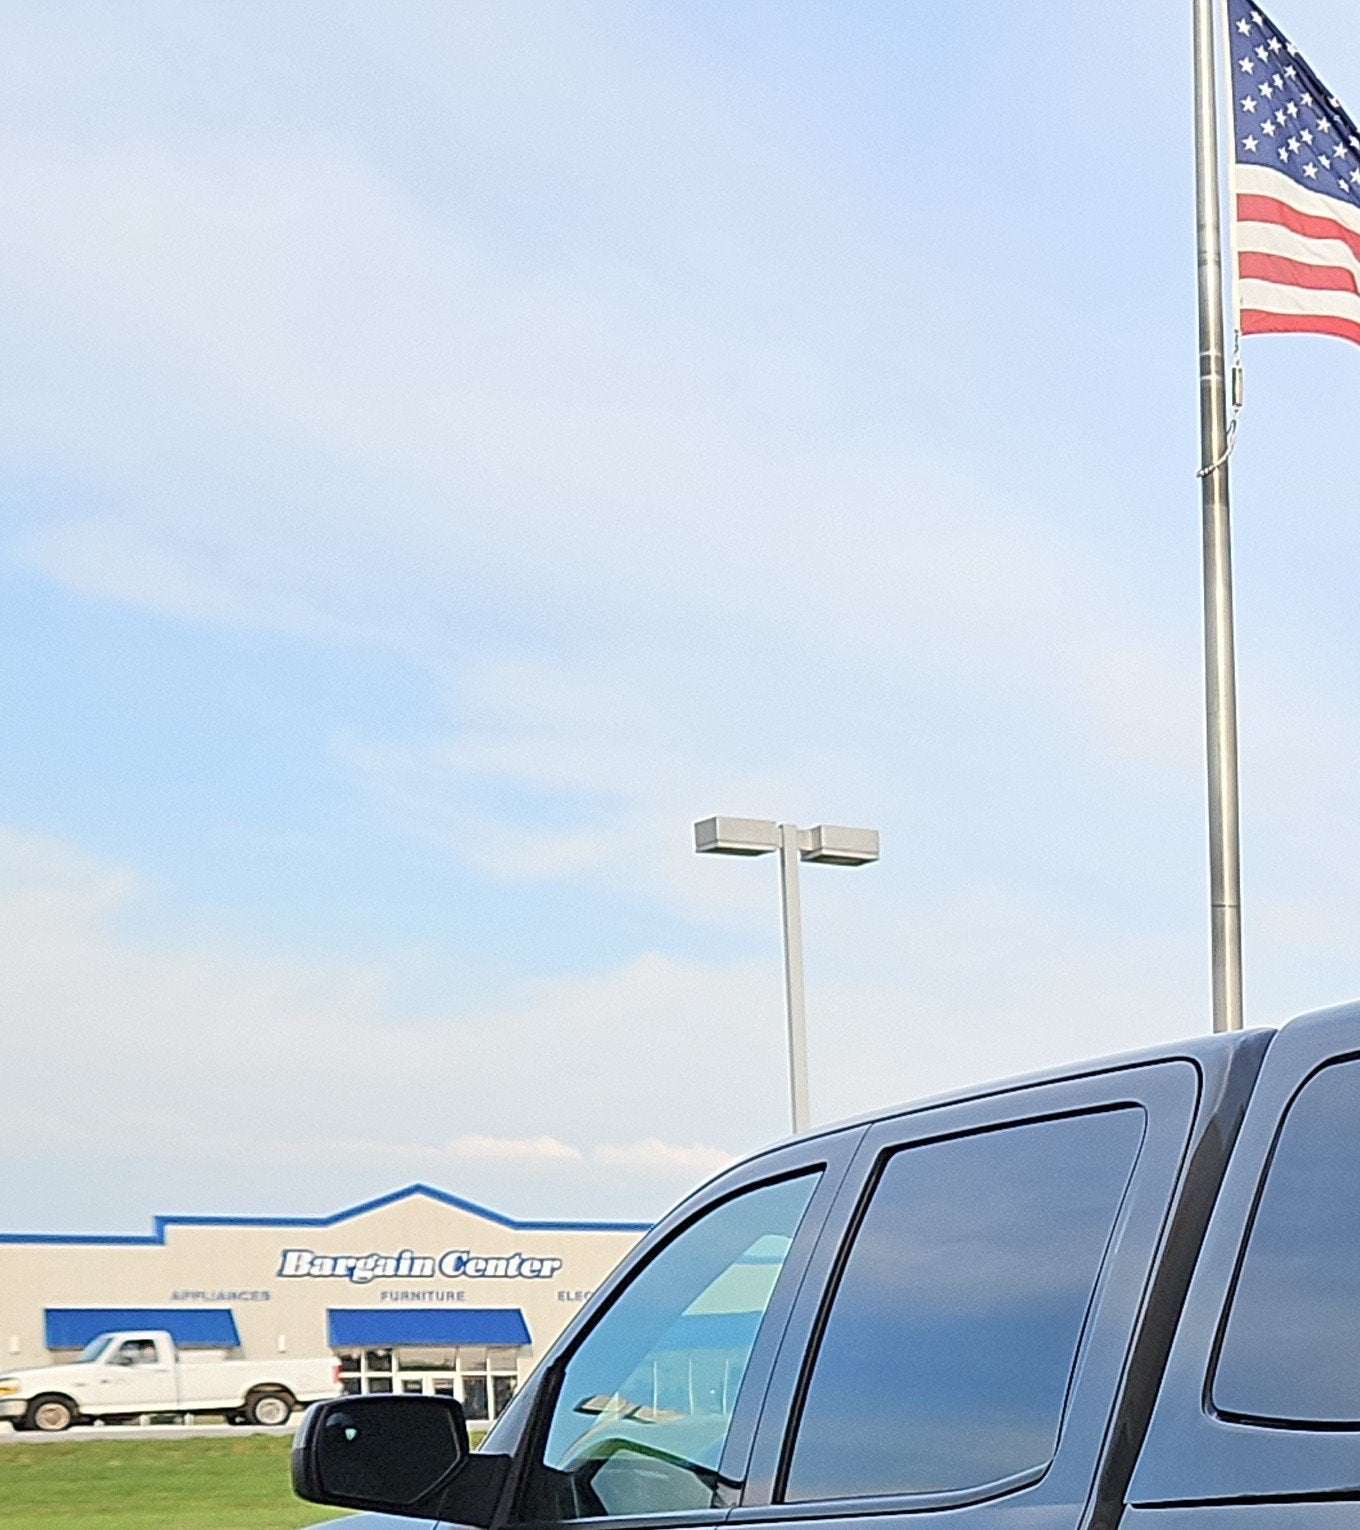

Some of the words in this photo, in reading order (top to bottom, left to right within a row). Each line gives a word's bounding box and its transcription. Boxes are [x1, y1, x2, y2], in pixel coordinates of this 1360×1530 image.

[276, 1248, 435, 1284] Bargain
[438, 1250, 563, 1278] Center
[380, 1290, 465, 1301] FURNITURE
